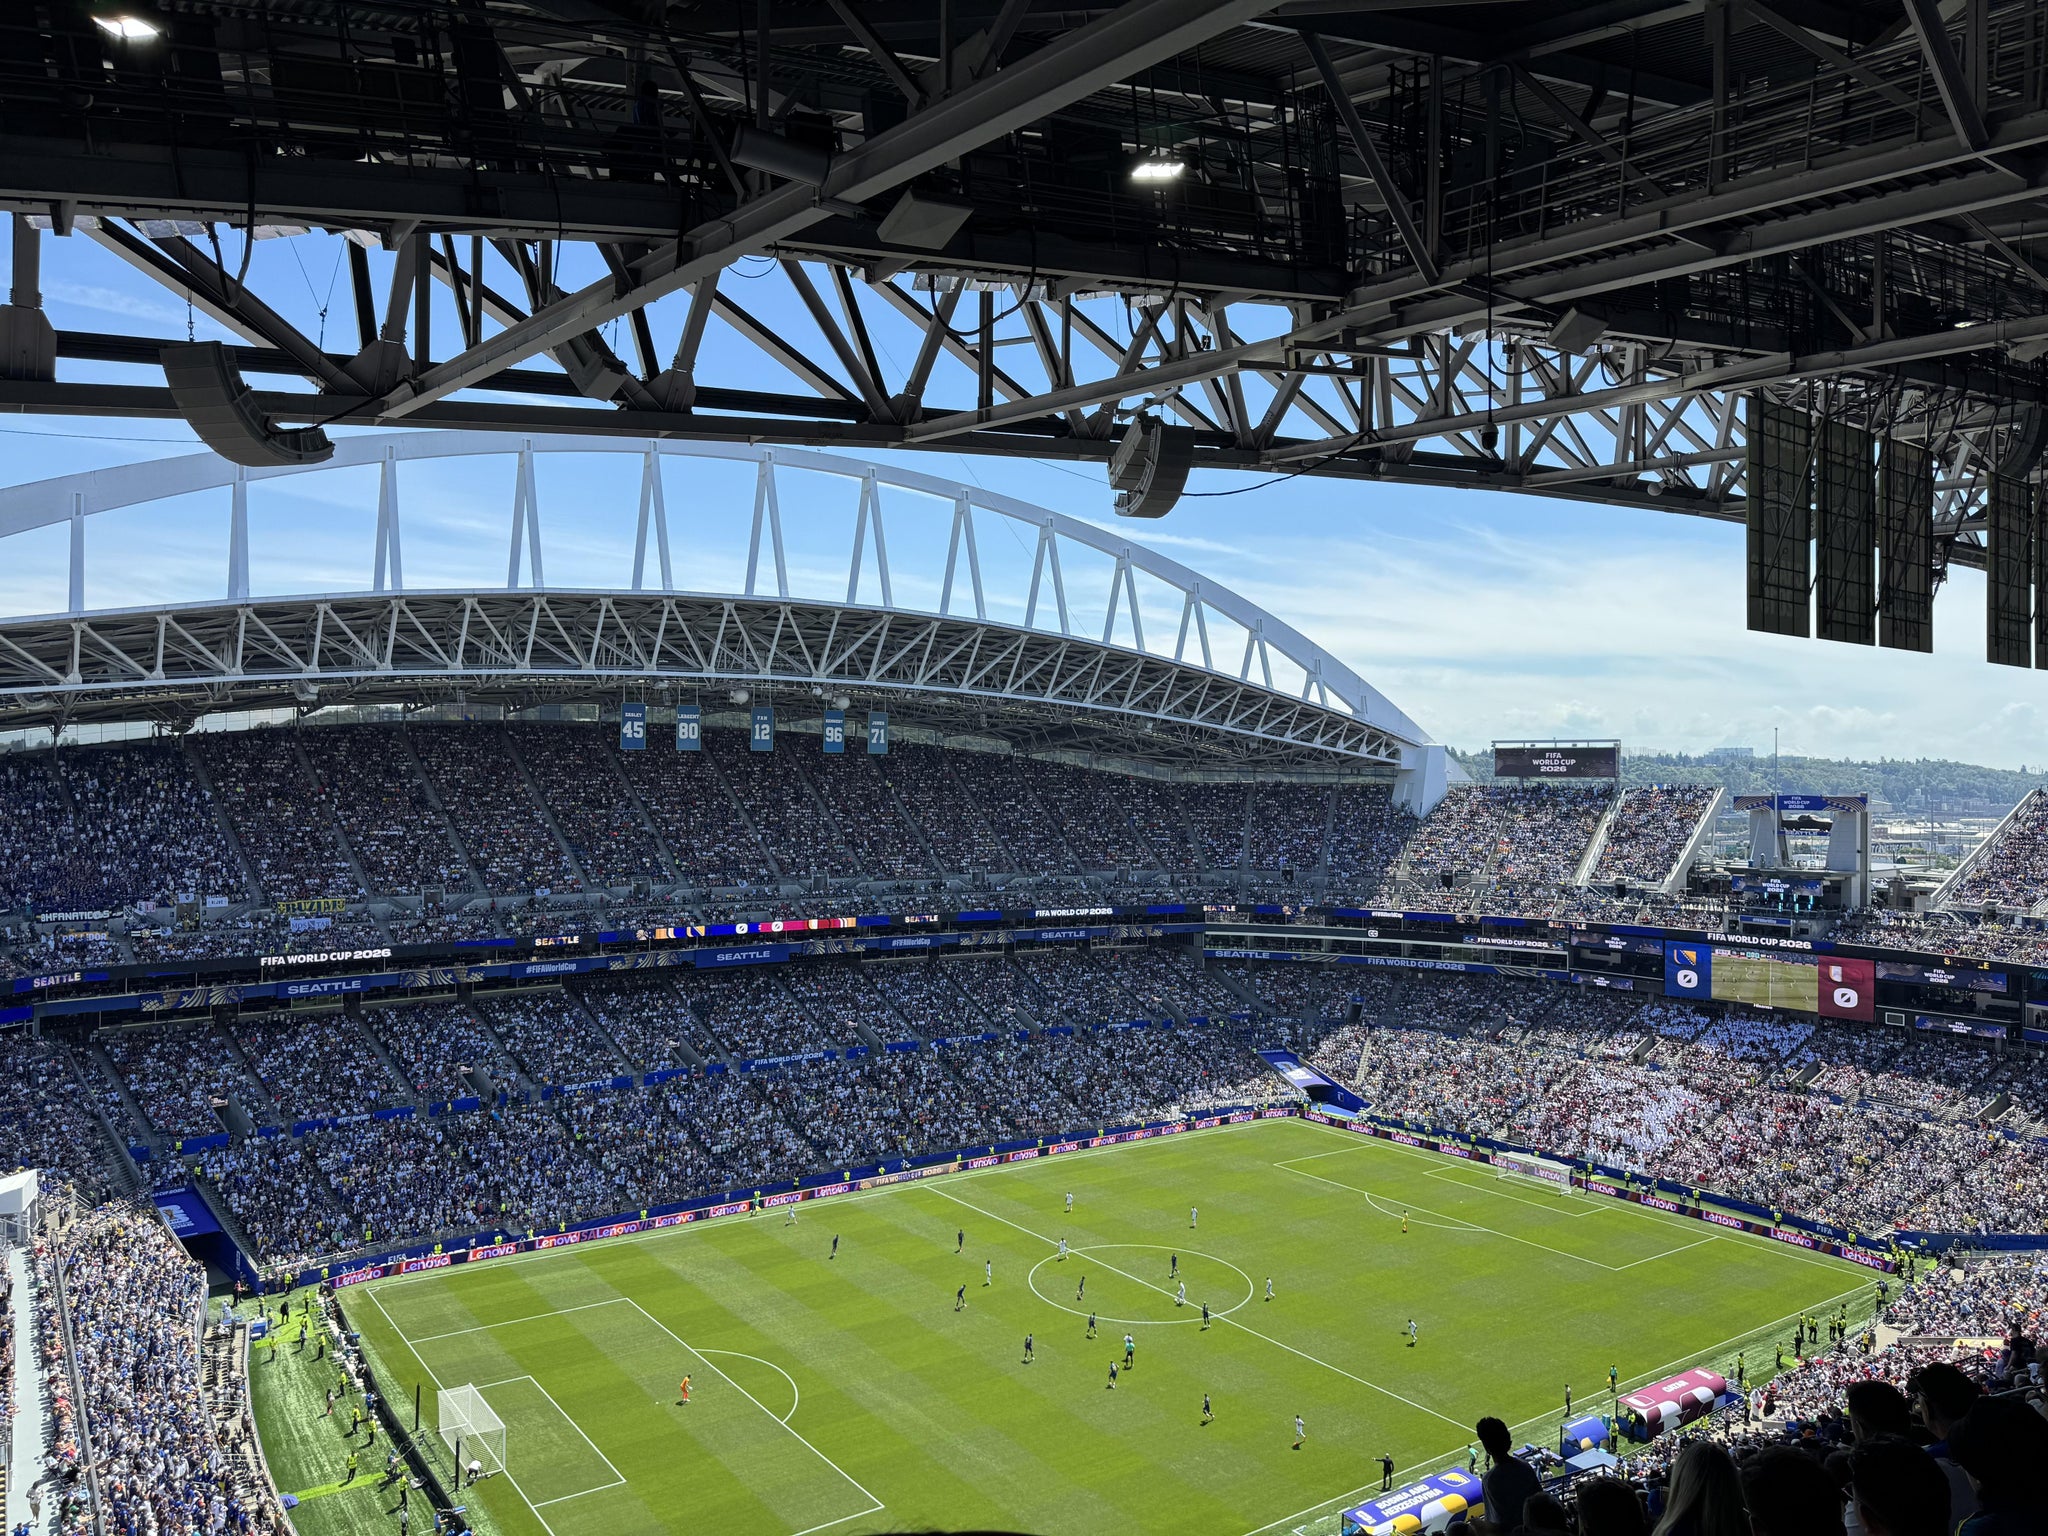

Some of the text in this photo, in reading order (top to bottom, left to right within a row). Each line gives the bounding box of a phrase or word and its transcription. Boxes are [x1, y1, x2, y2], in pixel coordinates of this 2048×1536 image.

[622, 721, 644, 739] 45
[679, 722, 699, 739] 80
[754, 724, 770, 740] 12
[825, 727, 843, 743] 96
[870, 728, 885, 744] 71
[905, 915, 939, 923] SEATTLE
[1548, 921, 1587, 930] SEATTLE
[535, 935, 580, 946] SEATTLE
[1041, 931, 1086, 939] SEATTLE
[1707, 932, 1812, 950] FIFA WORLD CUP 2026
[260, 948, 392, 967] FIFA WORLD CUP 2026
[716, 950, 771, 962] SEATTLE
[1215, 951, 1270, 959] SEATTLE
[526, 962, 577, 974] #FIFAWorldCup
[1435, 963, 1466, 971] 2026
[33, 972, 82, 988] SEATTLE
[1677, 969, 1698, 988] 0
[287, 980, 361, 994] SEATTLE
[1833, 987, 1859, 1008] 0
[564, 1078, 613, 1091] SEATTLE
[1229, 1112, 1254, 1123] Lenovo
[1262, 1109, 1289, 1118] Lenovo
[1304, 1111, 1329, 1124] Lenovo
[1161, 1125, 1186, 1135] Lenovo
[1195, 1118, 1221, 1130] Lenovo
[1347, 1122, 1374, 1135] Lenovo
[1089, 1136, 1116, 1147] Lenovo
[1126, 1131, 1151, 1141] Lenovo
[1391, 1133, 1420, 1146] Lenovo
[1009, 1149, 1039, 1162] Lenovo
[1439, 1143, 1469, 1158] Lenovo
[968, 1156, 998, 1169] Lenovo
[922, 1168, 942, 1177] 2026
[814, 1184, 849, 1198] Lenovo
[1582, 1179, 1616, 1196] Lenovo
[764, 1193, 801, 1208] Lenovo
[1640, 1194, 1677, 1212] Lenovo
[710, 1203, 748, 1218] Lenovo
[655, 1213, 694, 1227] Lenovo
[1703, 1211, 1742, 1229] Lenovo
[596, 1224, 637, 1239] Lenovo
[1816, 1224, 1833, 1236] FIFA
[535, 1232, 578, 1250] Lenovo
[1770, 1228, 1812, 1248] Lenovo
[1841, 1247, 1883, 1268] Lenovo
[402, 1257, 449, 1274] Lenovo
[335, 1268, 382, 1288] Lenovo
[1375, 1484, 1430, 1509] BOSNIA AND
[1381, 1488, 1444, 1518] HERZEGOVINA
